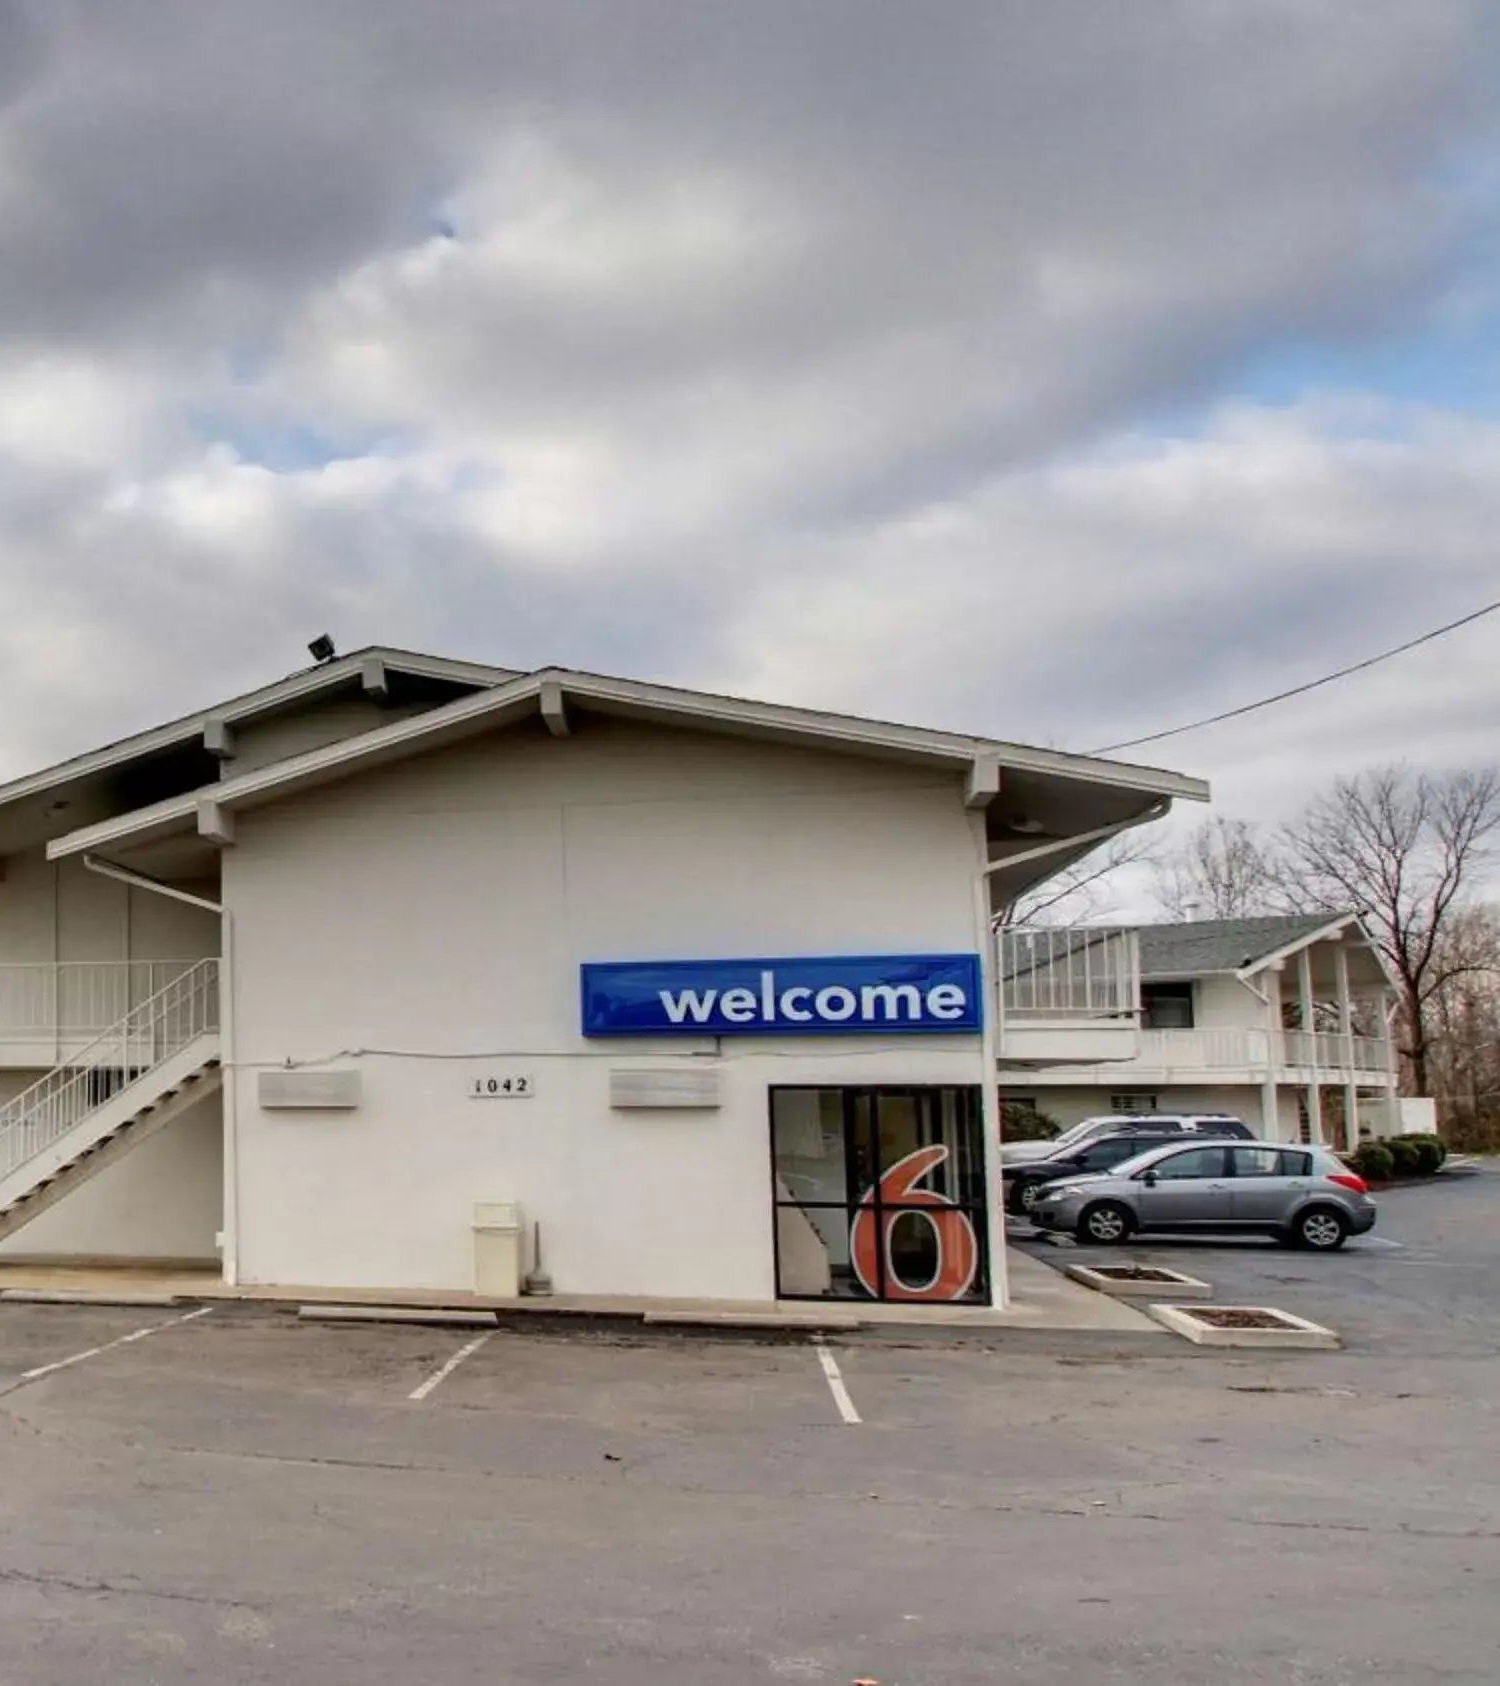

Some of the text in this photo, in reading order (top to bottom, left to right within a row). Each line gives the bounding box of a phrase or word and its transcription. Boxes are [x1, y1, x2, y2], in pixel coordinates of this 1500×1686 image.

[658, 970, 967, 1023] welcome
[475, 1077, 527, 1093] 1042
[850, 1143, 978, 1301] 6
